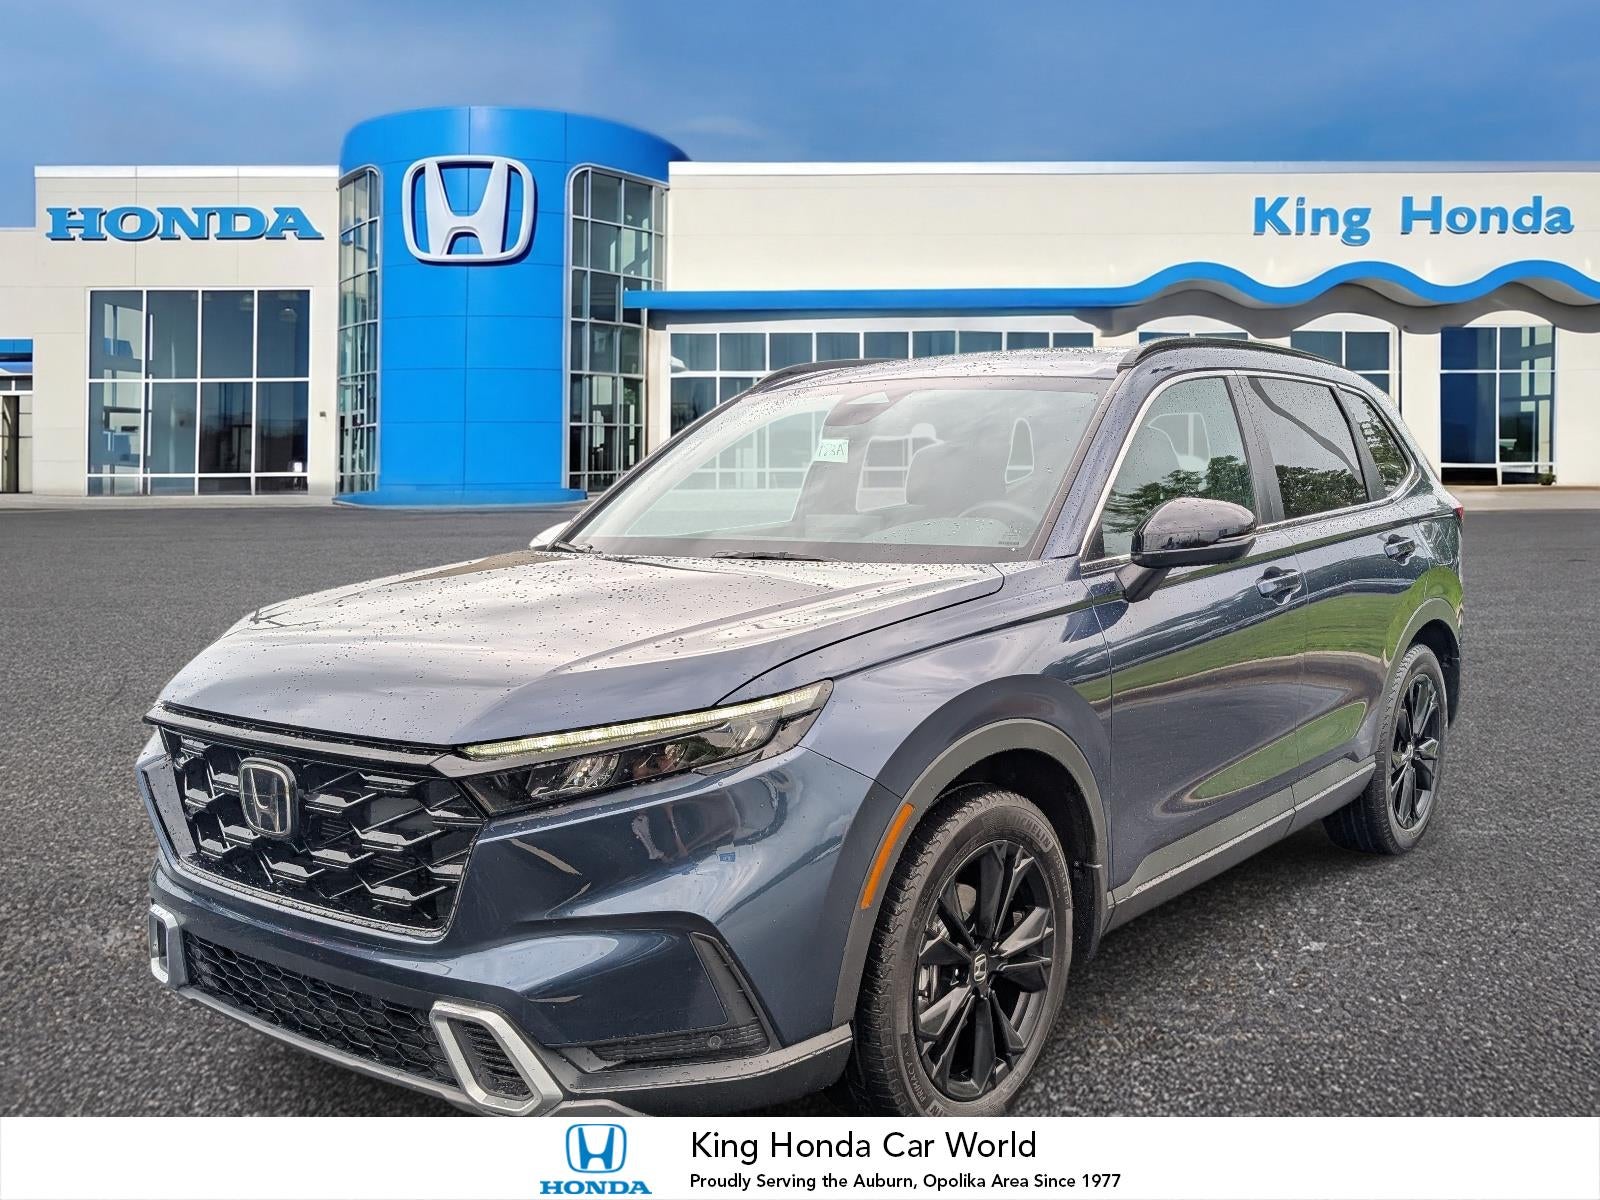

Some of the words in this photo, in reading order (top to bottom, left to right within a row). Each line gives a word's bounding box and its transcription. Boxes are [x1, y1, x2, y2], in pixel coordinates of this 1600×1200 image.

[45, 206, 324, 242] HONDA
[1253, 196, 1371, 247] King
[1400, 195, 1575, 235] Honda
